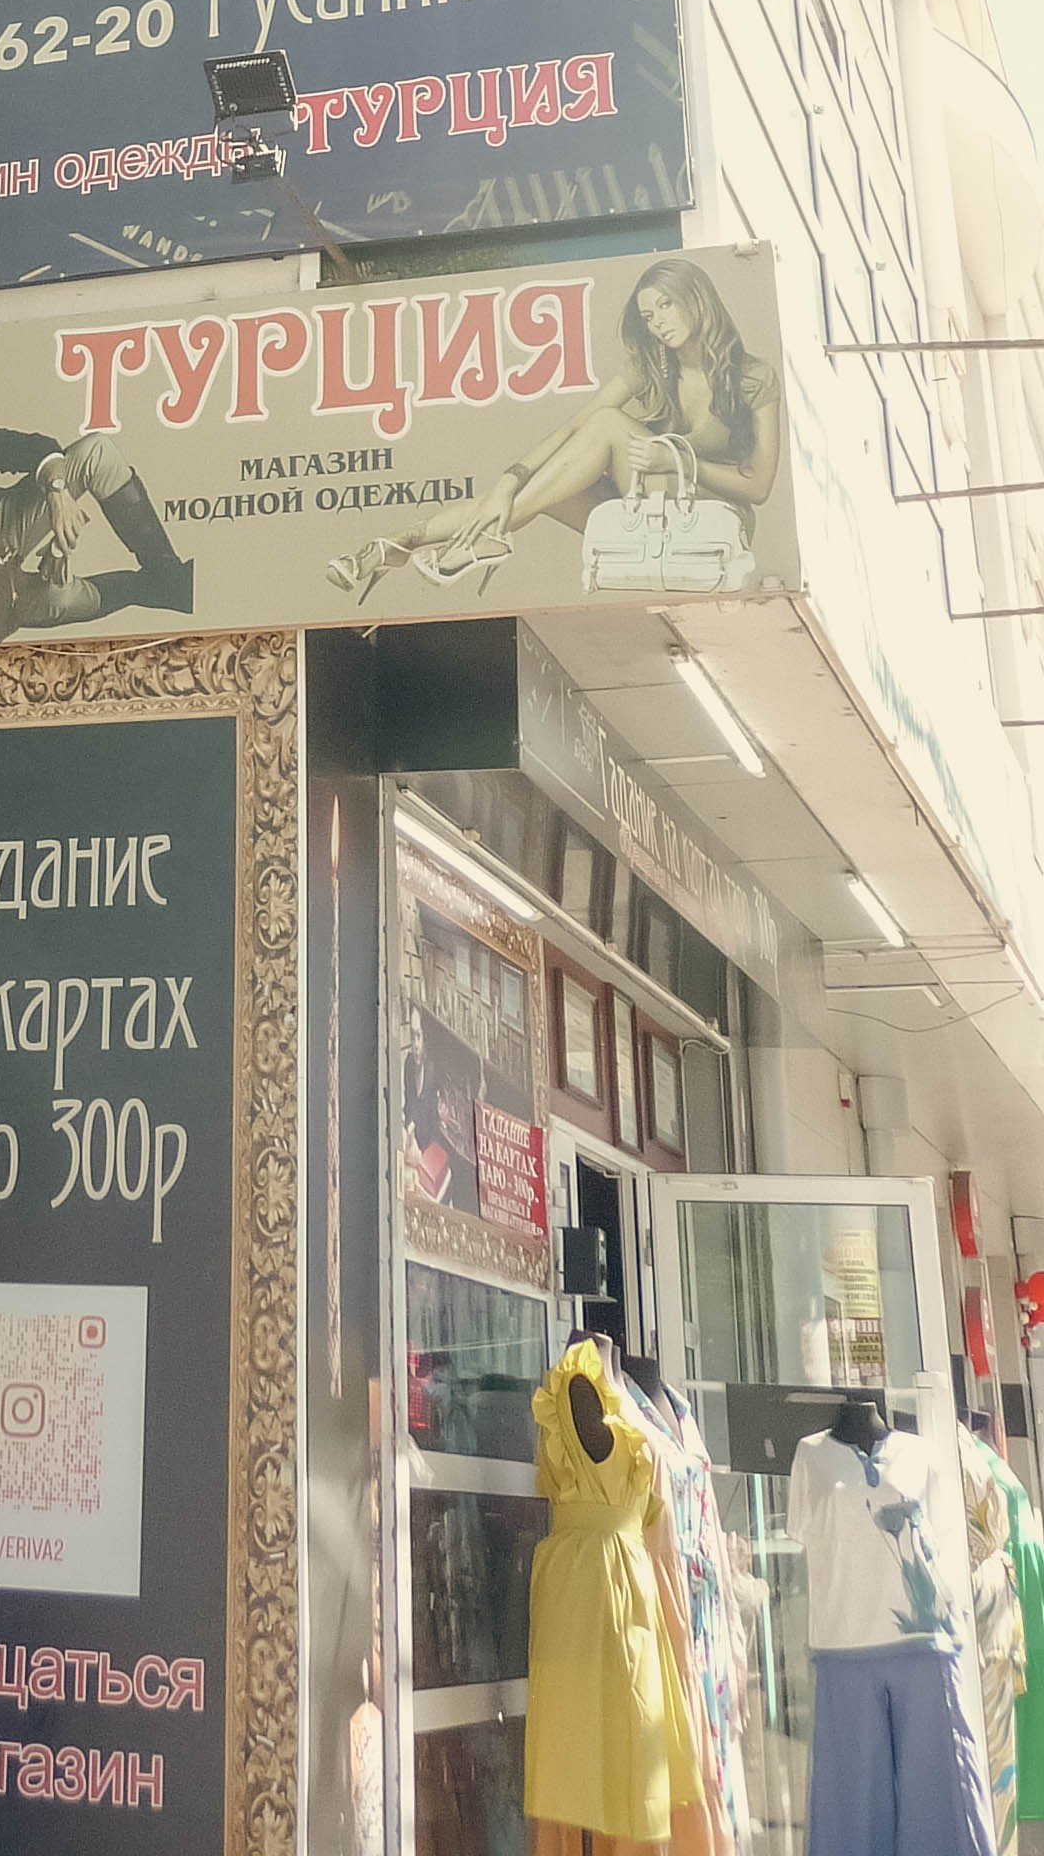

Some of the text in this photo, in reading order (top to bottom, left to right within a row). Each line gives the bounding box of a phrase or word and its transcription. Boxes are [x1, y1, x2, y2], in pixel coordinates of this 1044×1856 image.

[290, 52, 618, 154] ТУРЦИЯ
[55, 276, 599, 440] ТУРЦИЯ
[163, 475, 475, 526] МОДНОЙ ОДЕЖДЫ
[238, 447, 395, 484] МАГАЗИН
[50, 1097, 188, 1244] 300р
[479, 1160, 506, 1189] ТАРО
